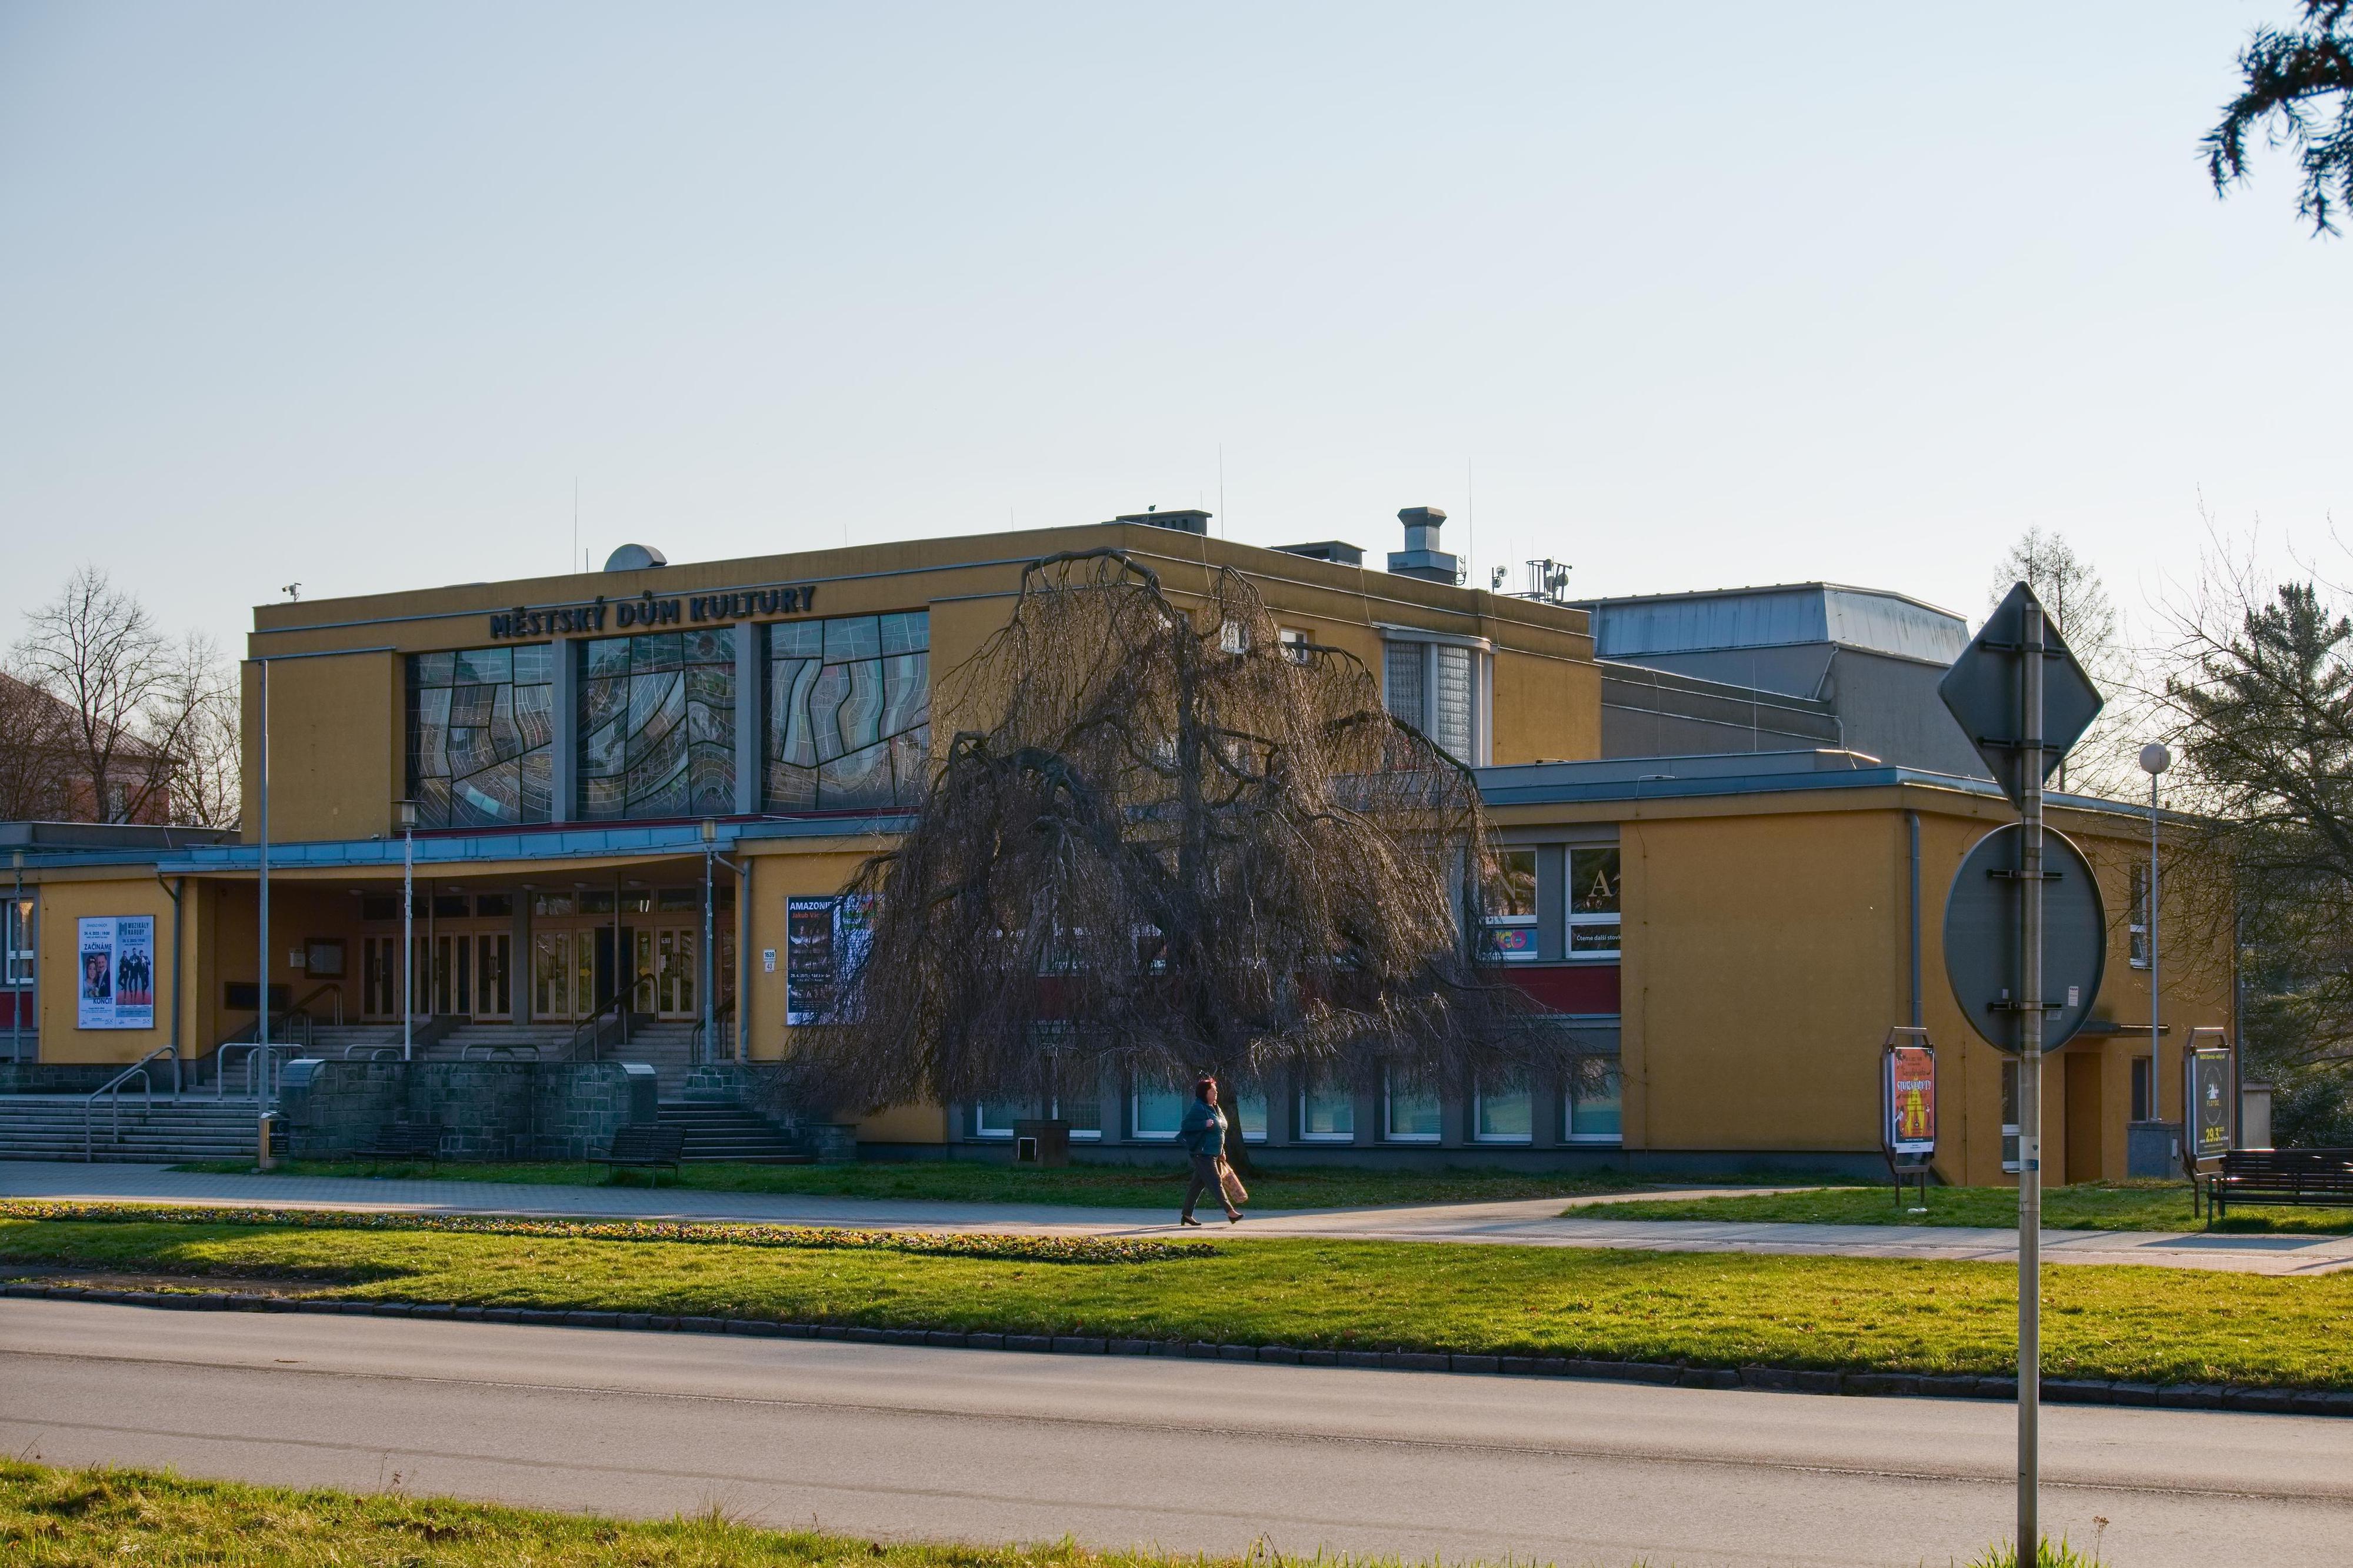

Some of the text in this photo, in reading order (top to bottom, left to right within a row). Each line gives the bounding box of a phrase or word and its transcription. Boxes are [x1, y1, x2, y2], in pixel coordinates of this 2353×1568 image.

[489, 586, 816, 638] MĚSTSKÝ DŮM KULTURY
[1588, 870, 1612, 897] A
[84, 942, 112, 950] ZAČÍNÁME
